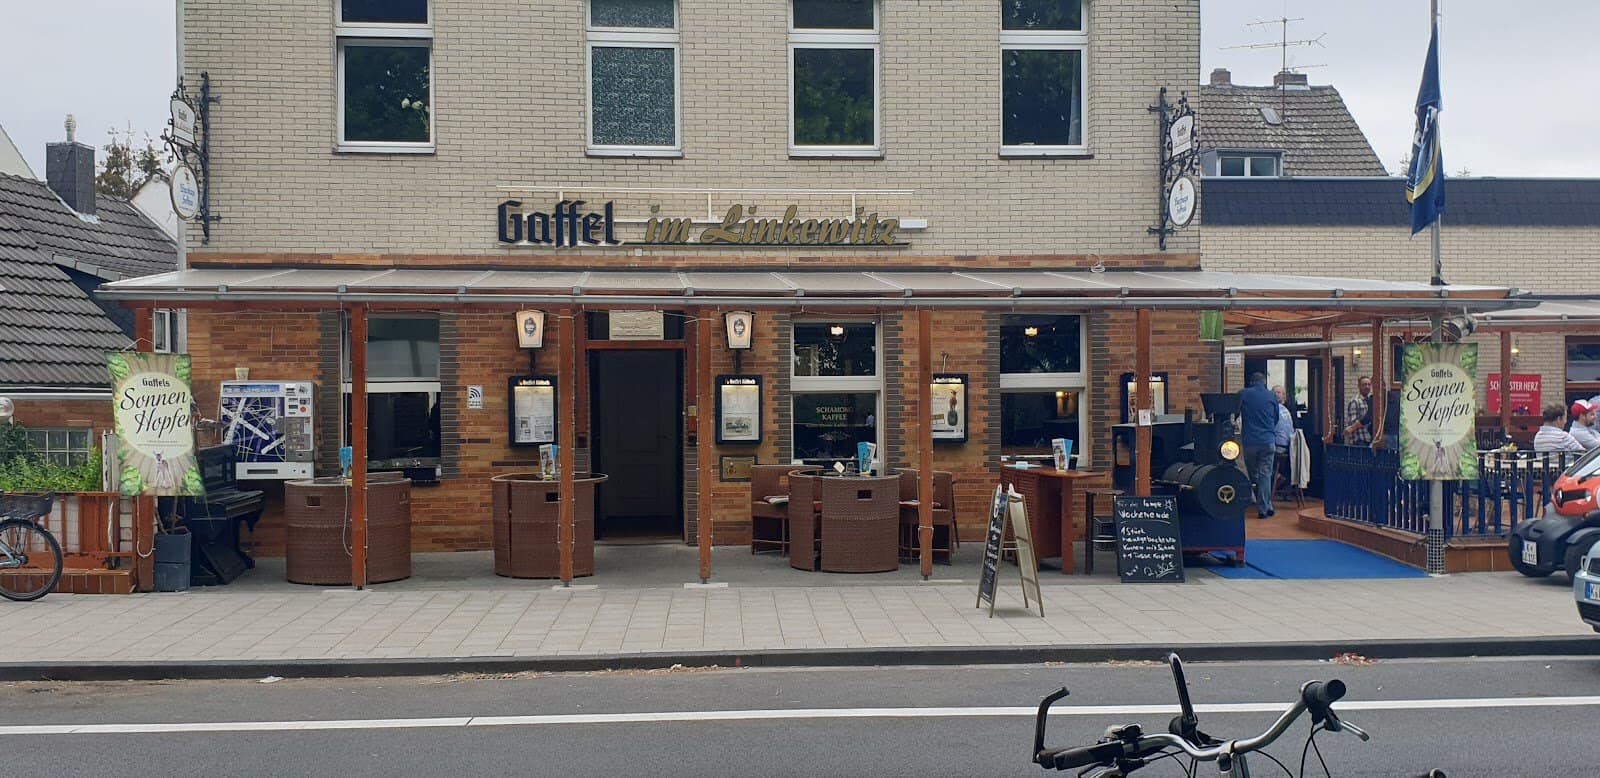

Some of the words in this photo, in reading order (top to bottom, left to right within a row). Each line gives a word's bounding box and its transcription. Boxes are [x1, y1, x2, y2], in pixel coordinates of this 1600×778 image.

[497, 200, 623, 248] Gaffel
[645, 205, 691, 243] im
[700, 204, 898, 244] Linkewitz
[142, 378, 170, 387] Gaffels
[1431, 369, 1453, 378] Gaffels
[1406, 379, 1465, 401] Sonnen
[1524, 381, 1538, 391] HERZ
[120, 387, 186, 410] Sonnen
[1418, 398, 1471, 427] Hopfen
